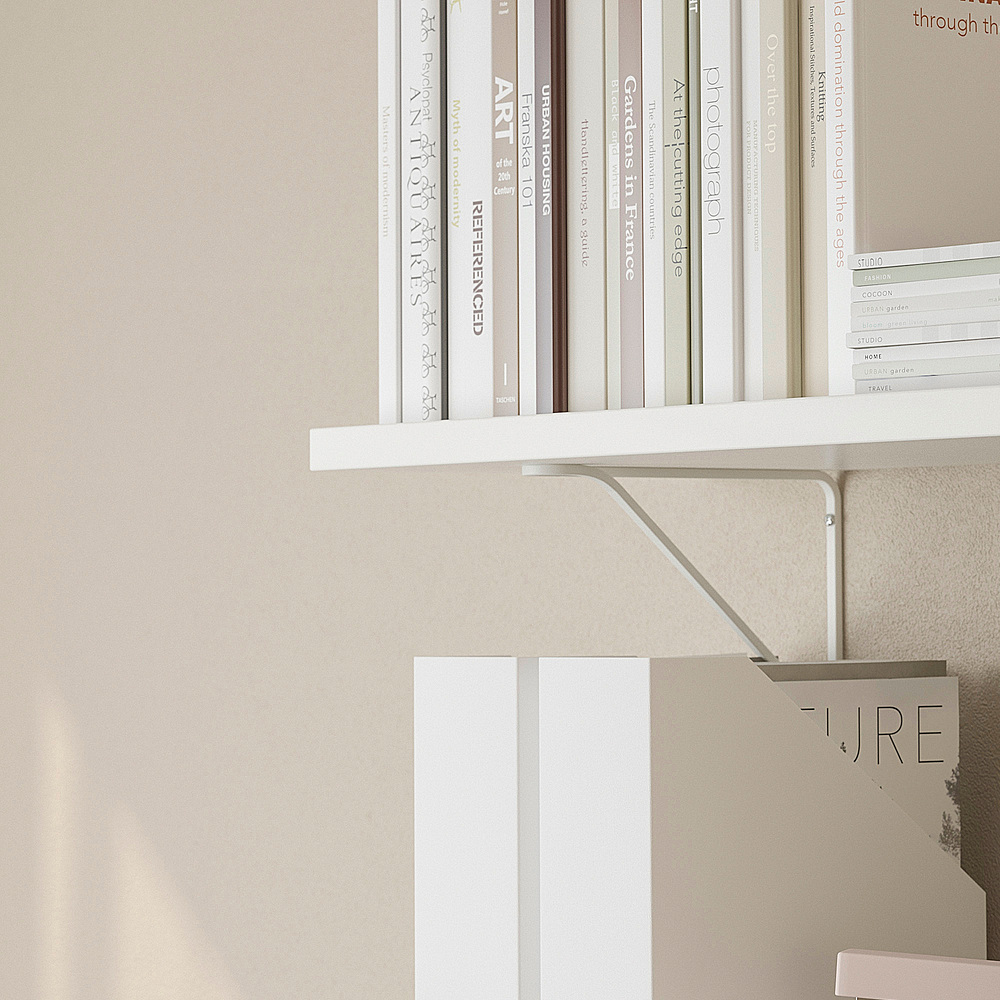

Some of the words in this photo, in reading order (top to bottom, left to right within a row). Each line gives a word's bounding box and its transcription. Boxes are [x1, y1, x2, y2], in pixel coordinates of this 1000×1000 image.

[913, 8, 977, 37] through
[766, 34, 778, 82] Over
[834, 22, 846, 118] domination
[611, 80, 619, 121] Black
[673, 78, 686, 102] At
[767, 88, 779, 117] the
[816, 71, 826, 122] Knitting
[451, 100, 461, 134] Myth
[494, 76, 514, 145] ART
[541, 84, 550, 140] URBAN
[624, 75, 637, 169] Gardens
[673, 108, 687, 140] the
[383, 106, 391, 153] Masters
[453, 139, 461, 152] of
[521, 93, 533, 168] Franska
[611, 130, 619, 156] and
[765, 124, 778, 153] top
[383, 155, 391, 169] of
[496, 159, 502, 168] of
[503, 157, 513, 168] the
[649, 123, 657, 190] Scandinavian
[703, 66, 725, 236] photograph
[833, 123, 847, 190] through
[451, 156, 461, 227] modernity
[493, 185, 515, 196] Century
[498, 171, 511, 182] 20th
[522, 176, 533, 208] 101
[542, 143, 551, 216] HOUSING
[611, 165, 619, 208] white
[625, 175, 638, 197] in
[671, 147, 686, 218] cutting
[382, 172, 391, 238] modernism
[581, 218, 588, 226] a
[649, 192, 657, 240] countries
[836, 195, 847, 222] the
[580, 229, 589, 268] guide
[625, 203, 638, 281] France
[672, 224, 688, 277] edge
[833, 228, 845, 268] ages
[472, 200, 484, 336] REFERENCED
[857, 257, 883, 268] STUDIO
[864, 274, 892, 282] FASHION
[861, 290, 893, 299] COCOON
[861, 306, 884, 314] URBAN
[885, 304, 909, 312] garden
[857, 336, 883, 345] STUDIO
[864, 368, 888, 376] URBAN
[889, 367, 915, 376] garden
[868, 384, 893, 392] TRAVEL
